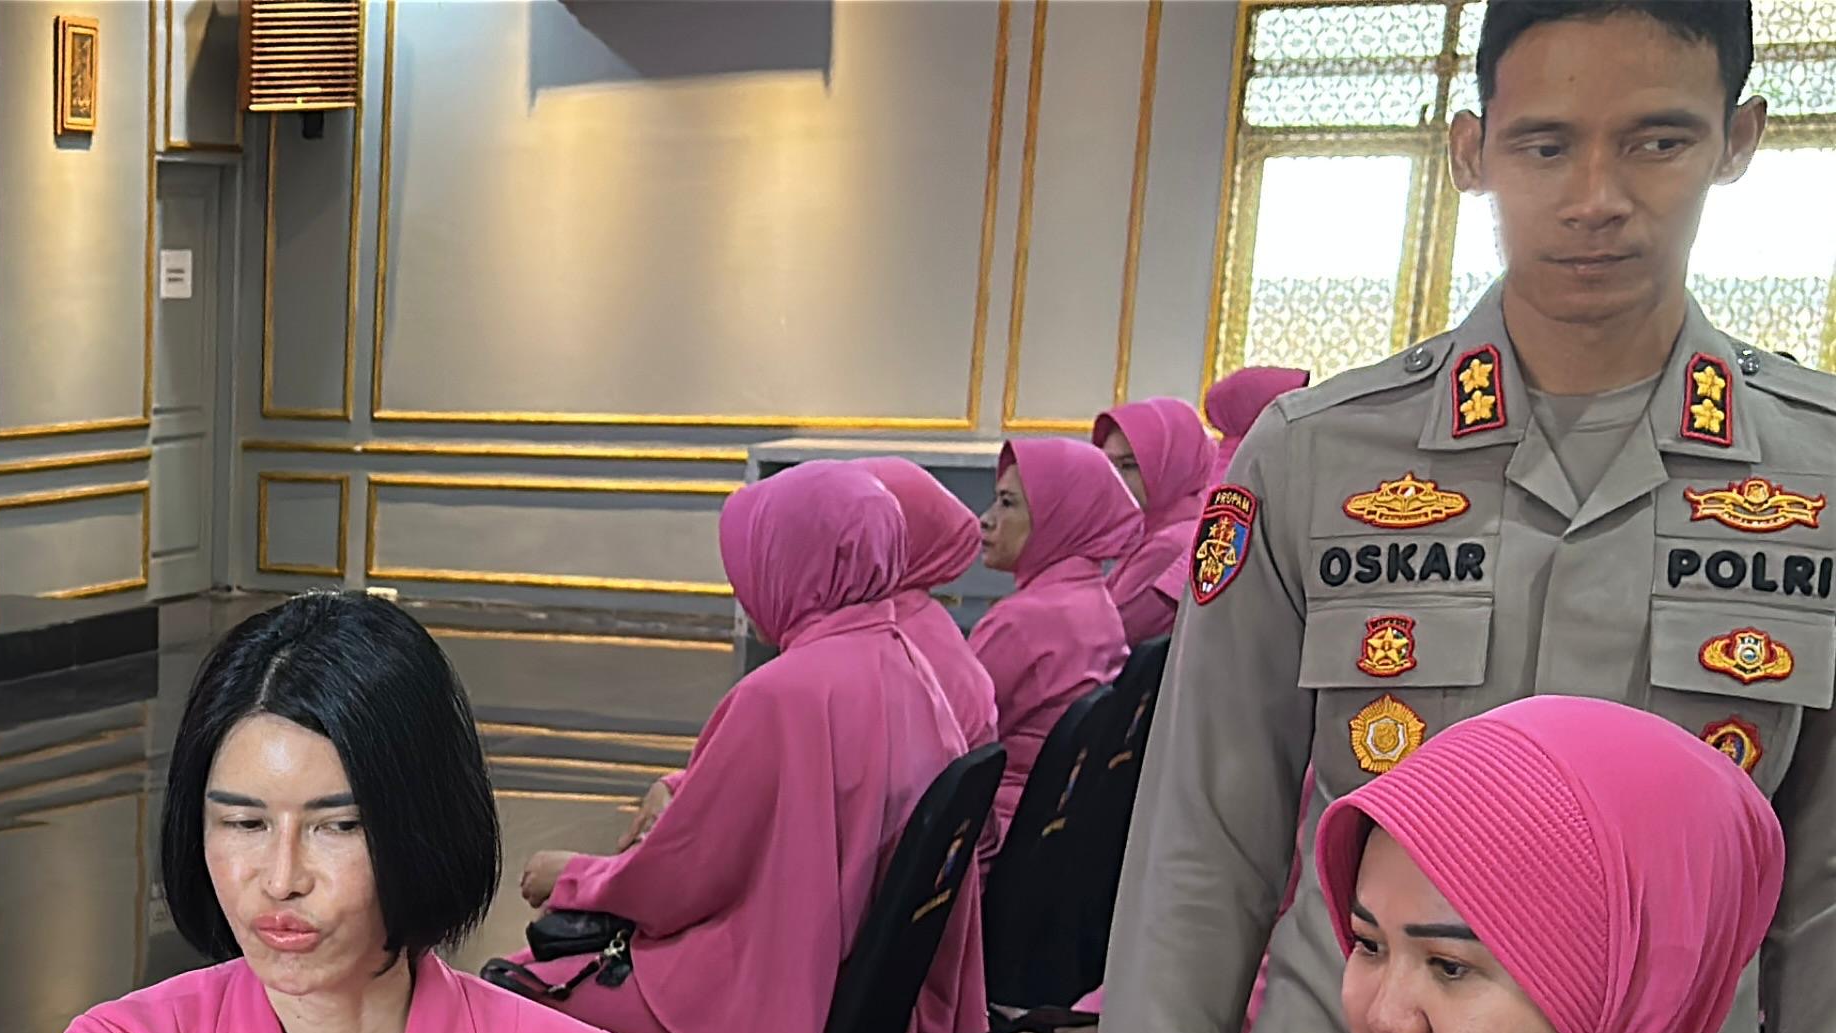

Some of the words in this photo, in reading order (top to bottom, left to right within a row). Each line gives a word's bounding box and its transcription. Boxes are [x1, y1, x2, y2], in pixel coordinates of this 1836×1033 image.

[1214, 490, 1251, 512] PROPAM
[1320, 542, 1486, 588] OSKAR
[1667, 548, 1834, 599] POLRI
